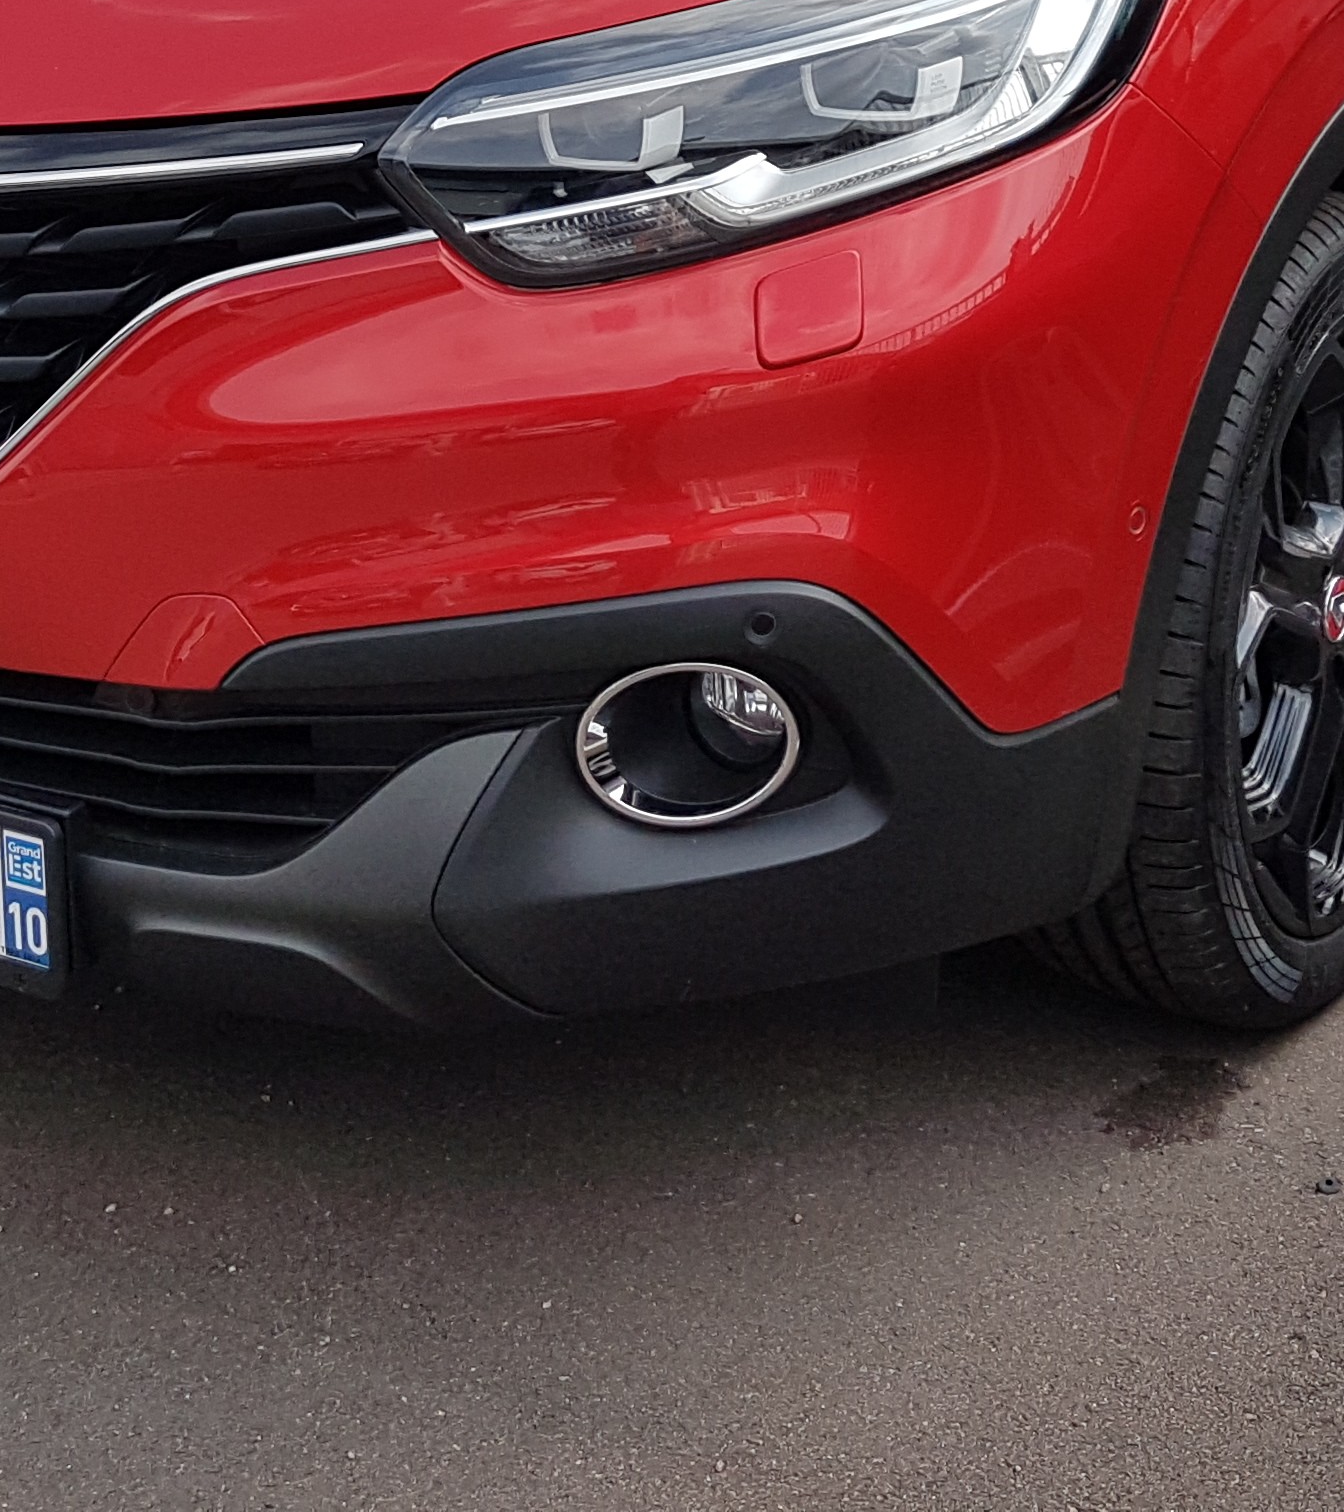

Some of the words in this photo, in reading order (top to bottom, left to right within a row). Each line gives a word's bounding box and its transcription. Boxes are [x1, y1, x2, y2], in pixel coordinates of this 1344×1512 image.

[8, 841, 41, 860] Grand
[8, 853, 42, 883] Est
[8, 901, 48, 956] 10
